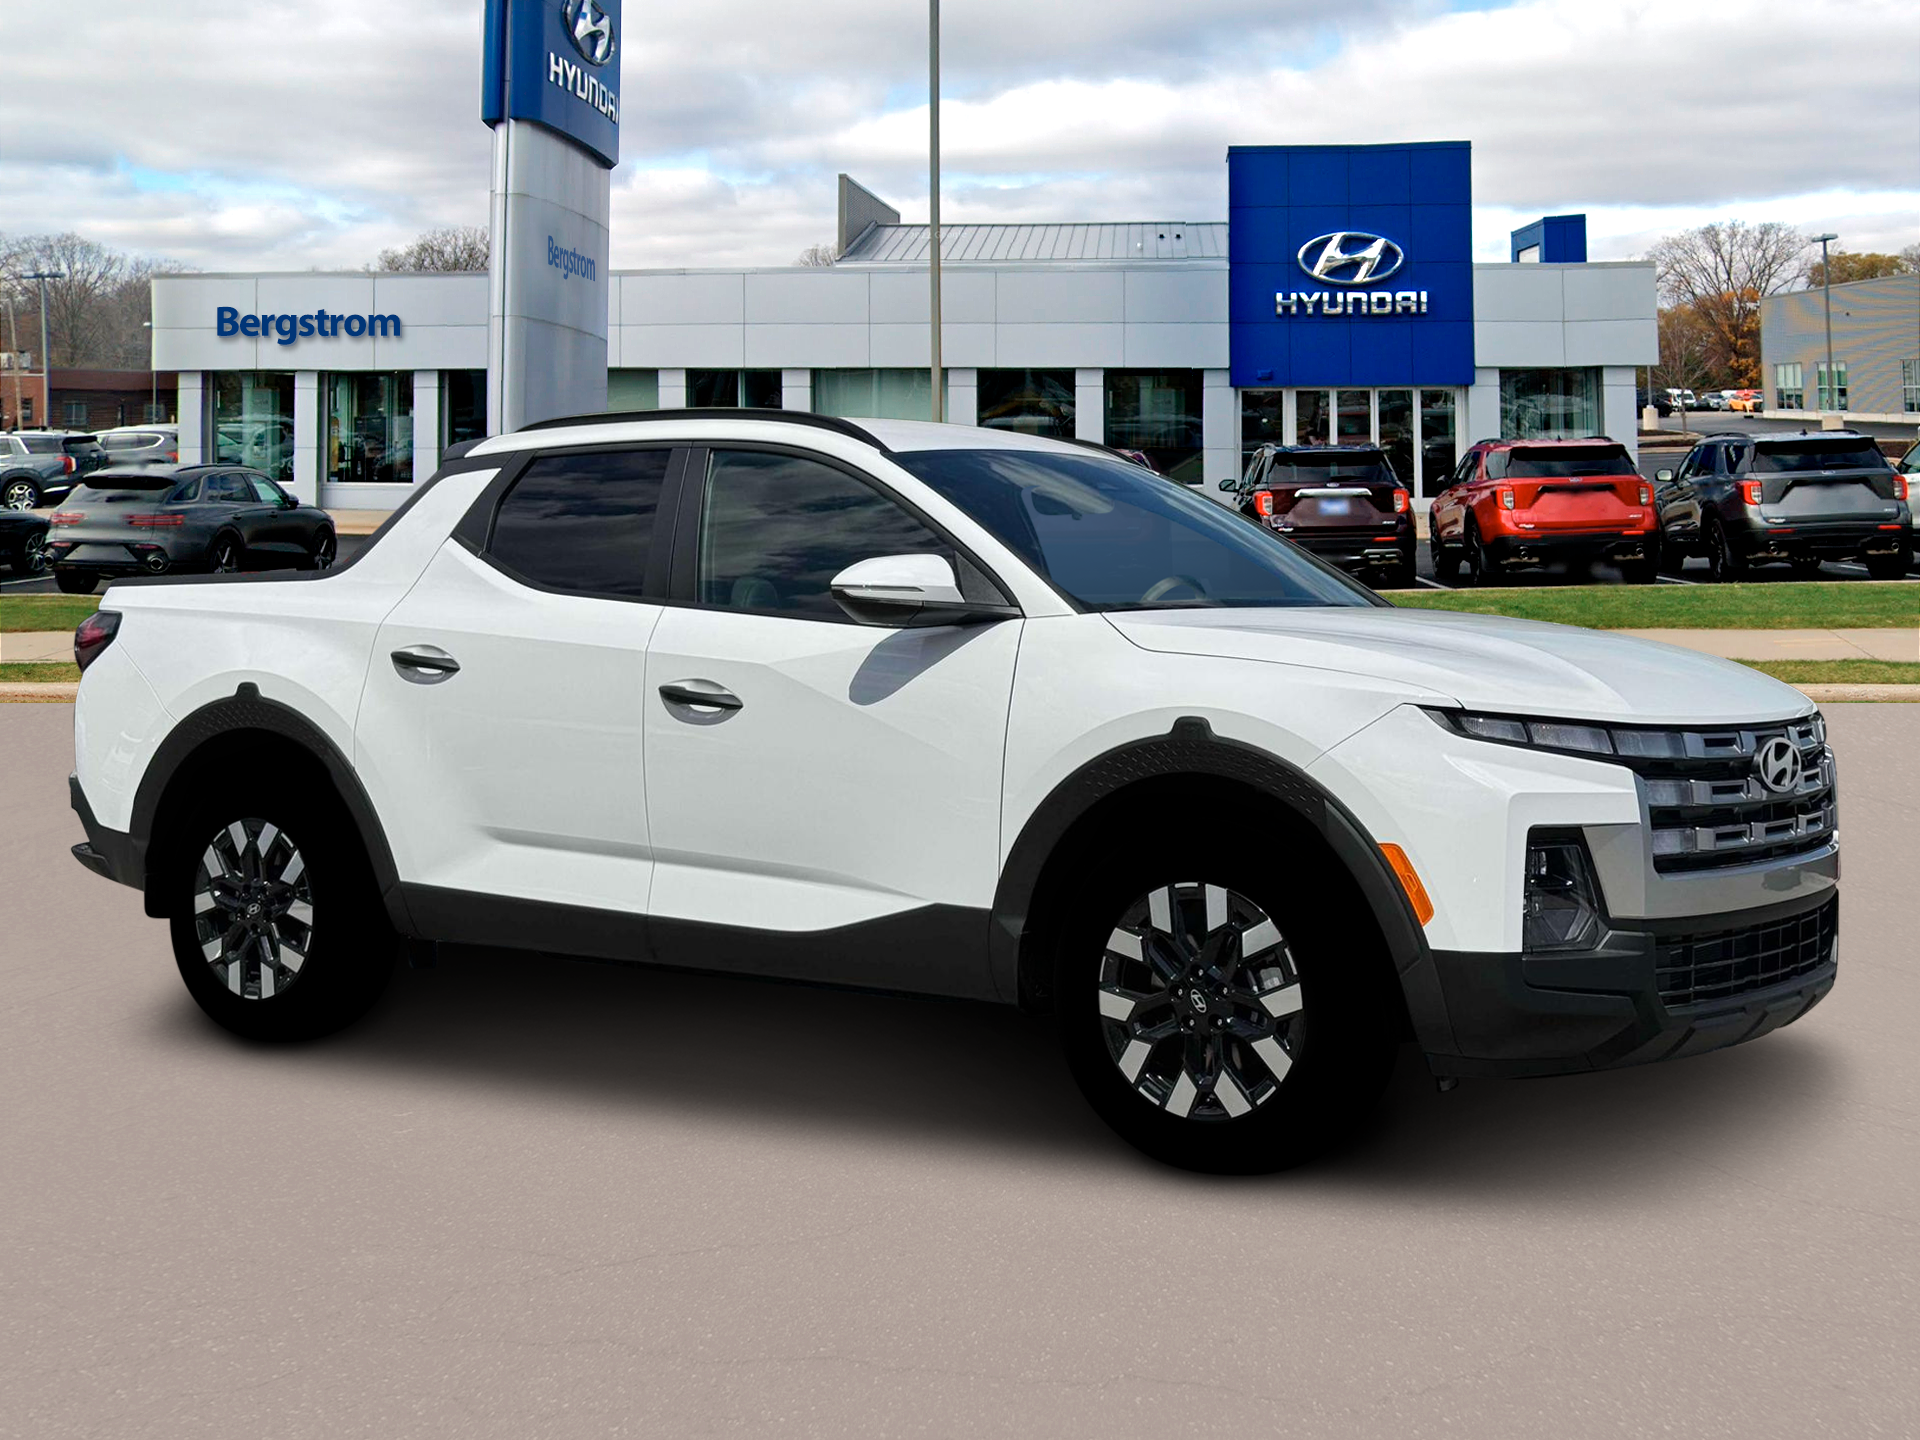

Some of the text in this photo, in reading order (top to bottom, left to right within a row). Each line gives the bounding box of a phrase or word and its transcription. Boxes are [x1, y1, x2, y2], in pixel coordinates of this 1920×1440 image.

[549, 52, 619, 124] HYUNDAI
[548, 235, 596, 282] Bergstrom
[1275, 290, 1428, 315] HYUNDAI
[217, 306, 401, 345] Bergstrom
